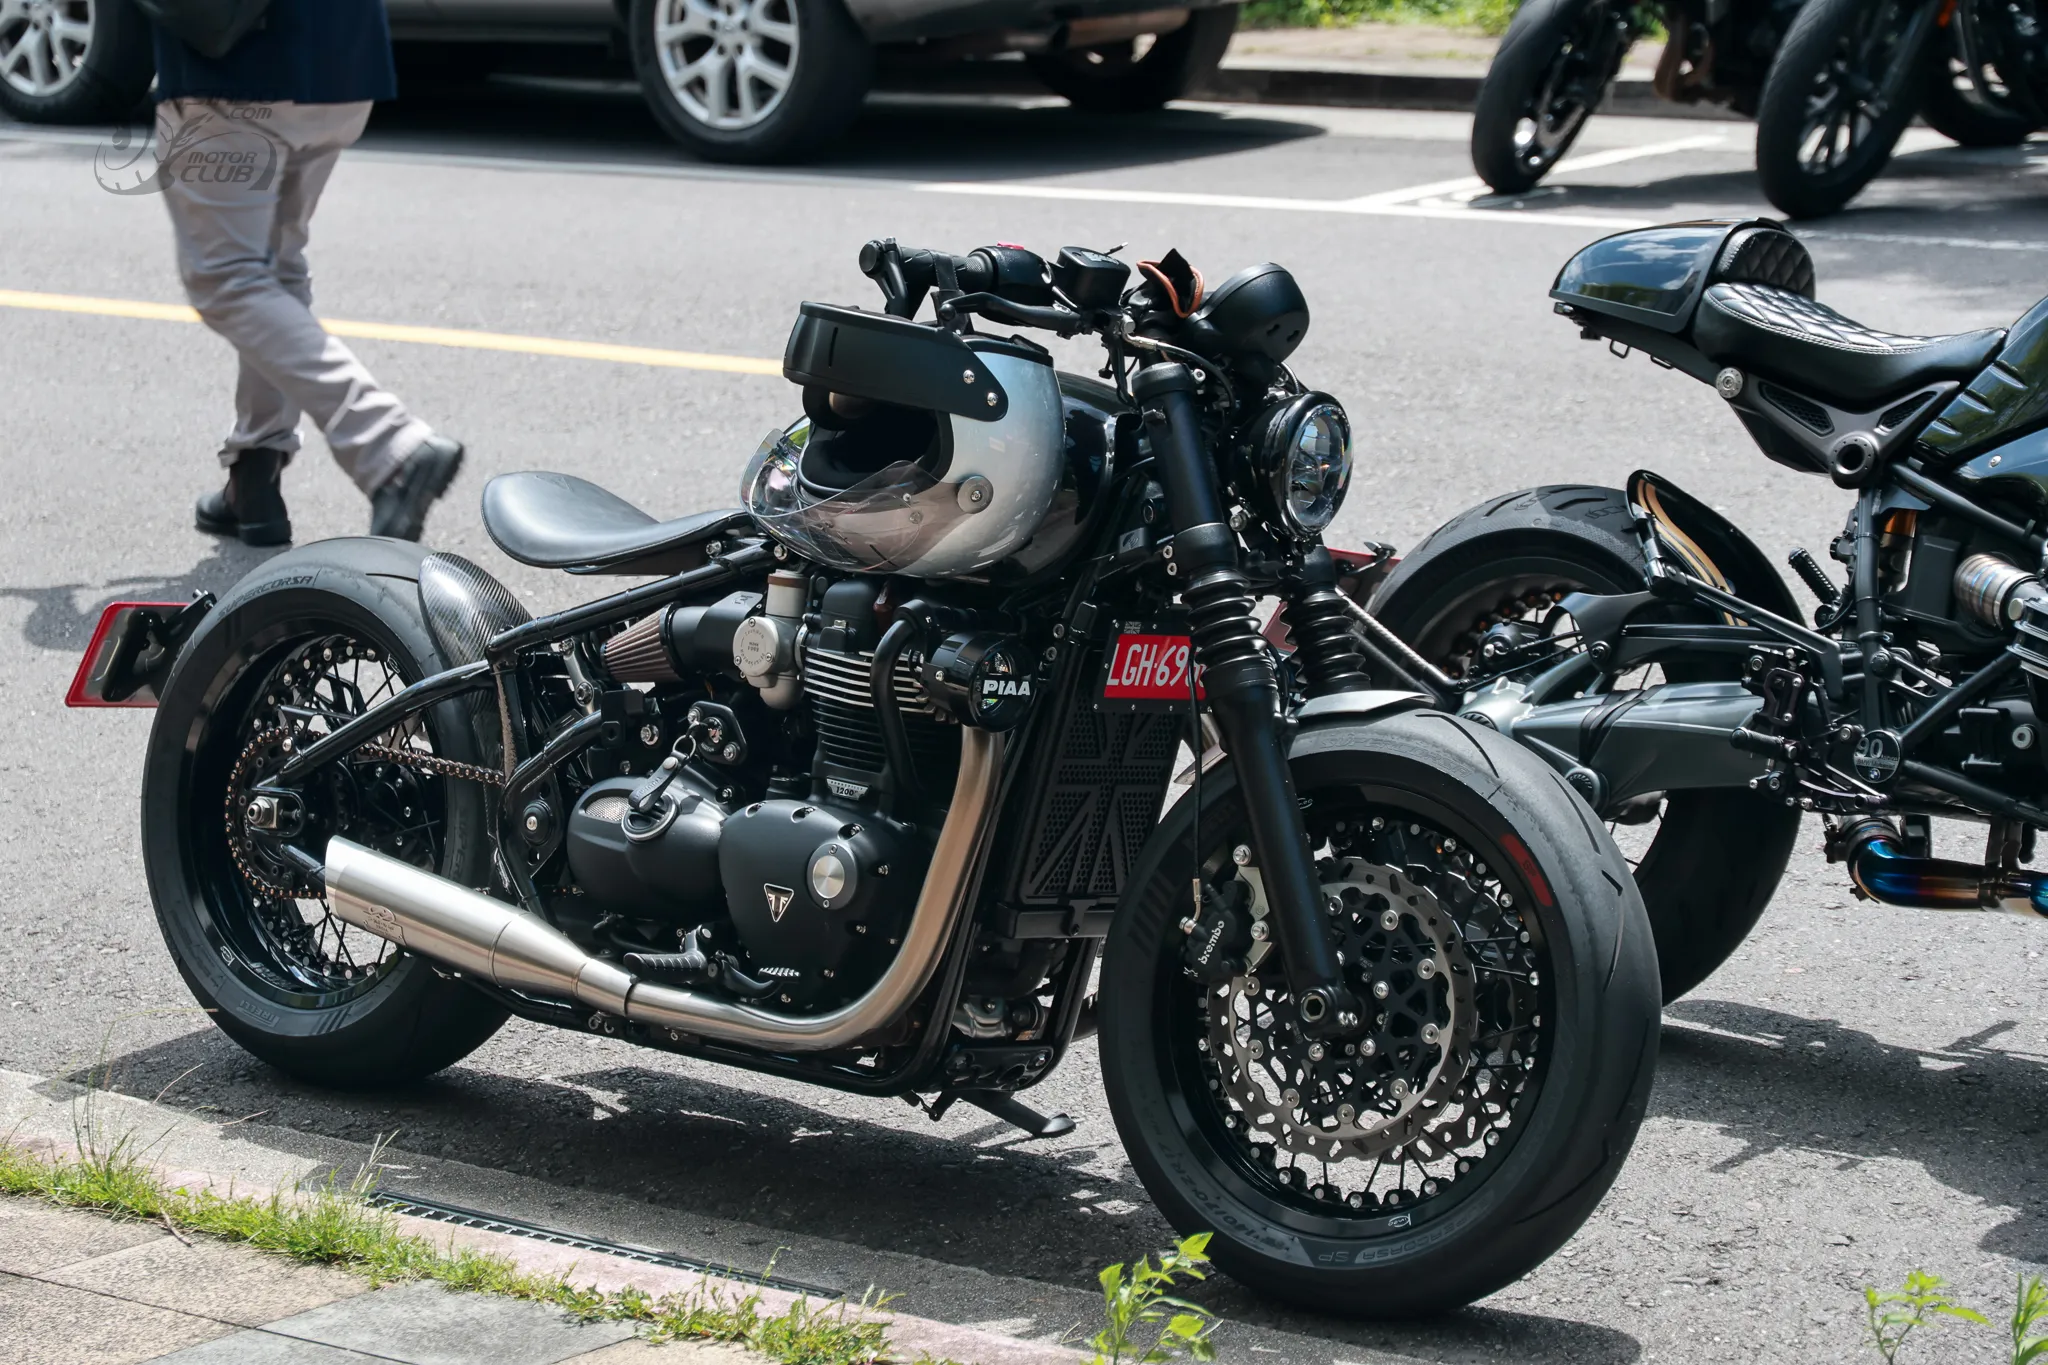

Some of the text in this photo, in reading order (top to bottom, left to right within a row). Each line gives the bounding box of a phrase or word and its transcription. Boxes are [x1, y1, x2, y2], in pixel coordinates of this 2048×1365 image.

[217, 575, 314, 618] SUPERCORSA
[1106, 643, 1208, 688] LGH-69
[982, 679, 1031, 696] PIAA
[1856, 737, 1884, 759] 90
[1197, 919, 1226, 966] brembo
[235, 999, 281, 1028] PIRELLI
[1317, 1250, 1350, 1262] SP
